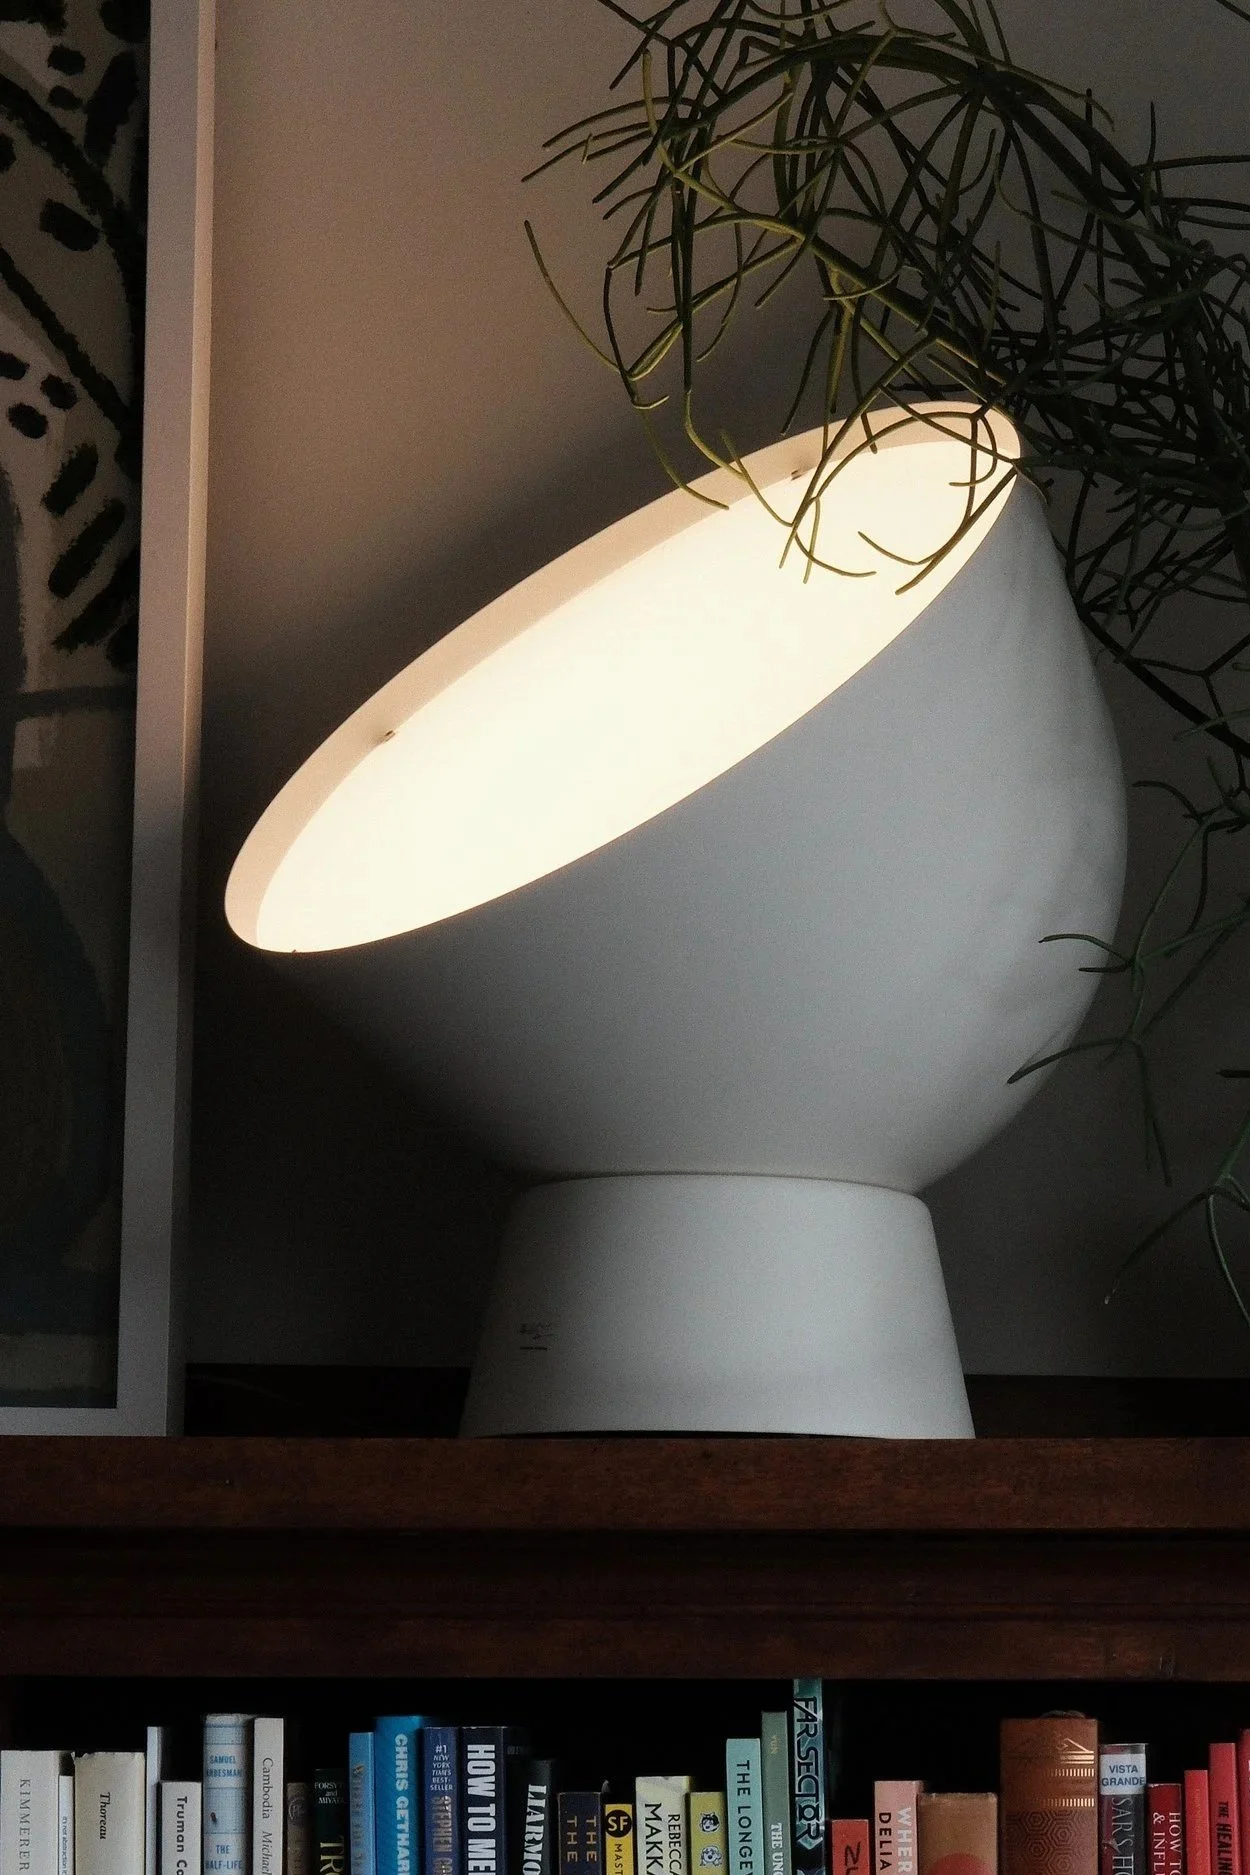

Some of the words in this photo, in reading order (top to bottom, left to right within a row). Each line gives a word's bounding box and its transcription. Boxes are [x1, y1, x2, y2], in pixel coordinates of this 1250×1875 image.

[468, 1744, 494, 1797] HOW
[18, 1779, 30, 1872] KIMMERER
[99, 1792, 111, 1839] Thoreau
[176, 1796, 188, 1853] Truman
[468, 1804, 494, 1833] TO
